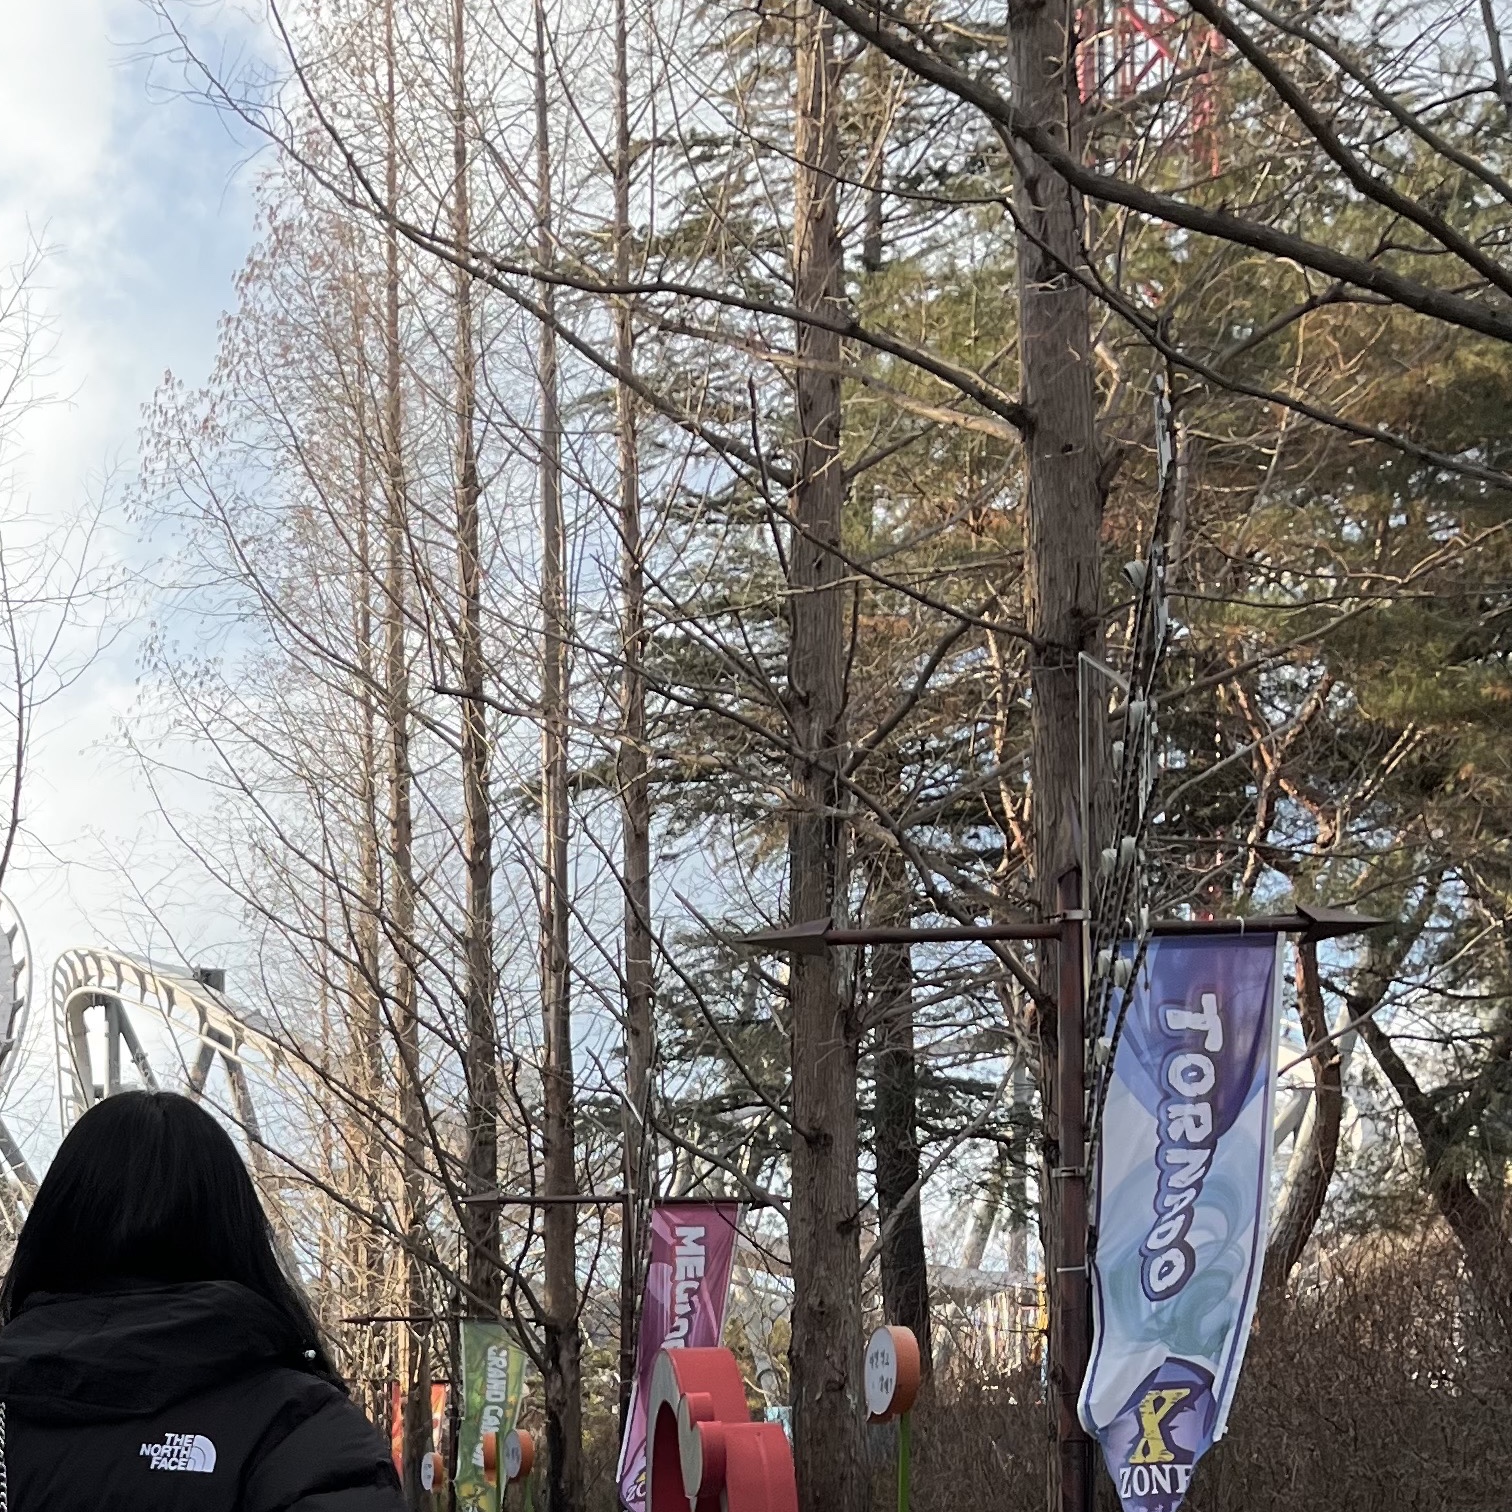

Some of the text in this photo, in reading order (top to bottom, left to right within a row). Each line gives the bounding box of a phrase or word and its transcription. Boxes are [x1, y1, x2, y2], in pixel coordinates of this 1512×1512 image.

[1147, 992, 1224, 1293] TORNADO
[486, 1345, 508, 1402] GRAND
[164, 1432, 194, 1446] THE
[1129, 1388, 1191, 1464] X
[139, 1443, 191, 1458] NORTH
[150, 1456, 188, 1471] FACE
